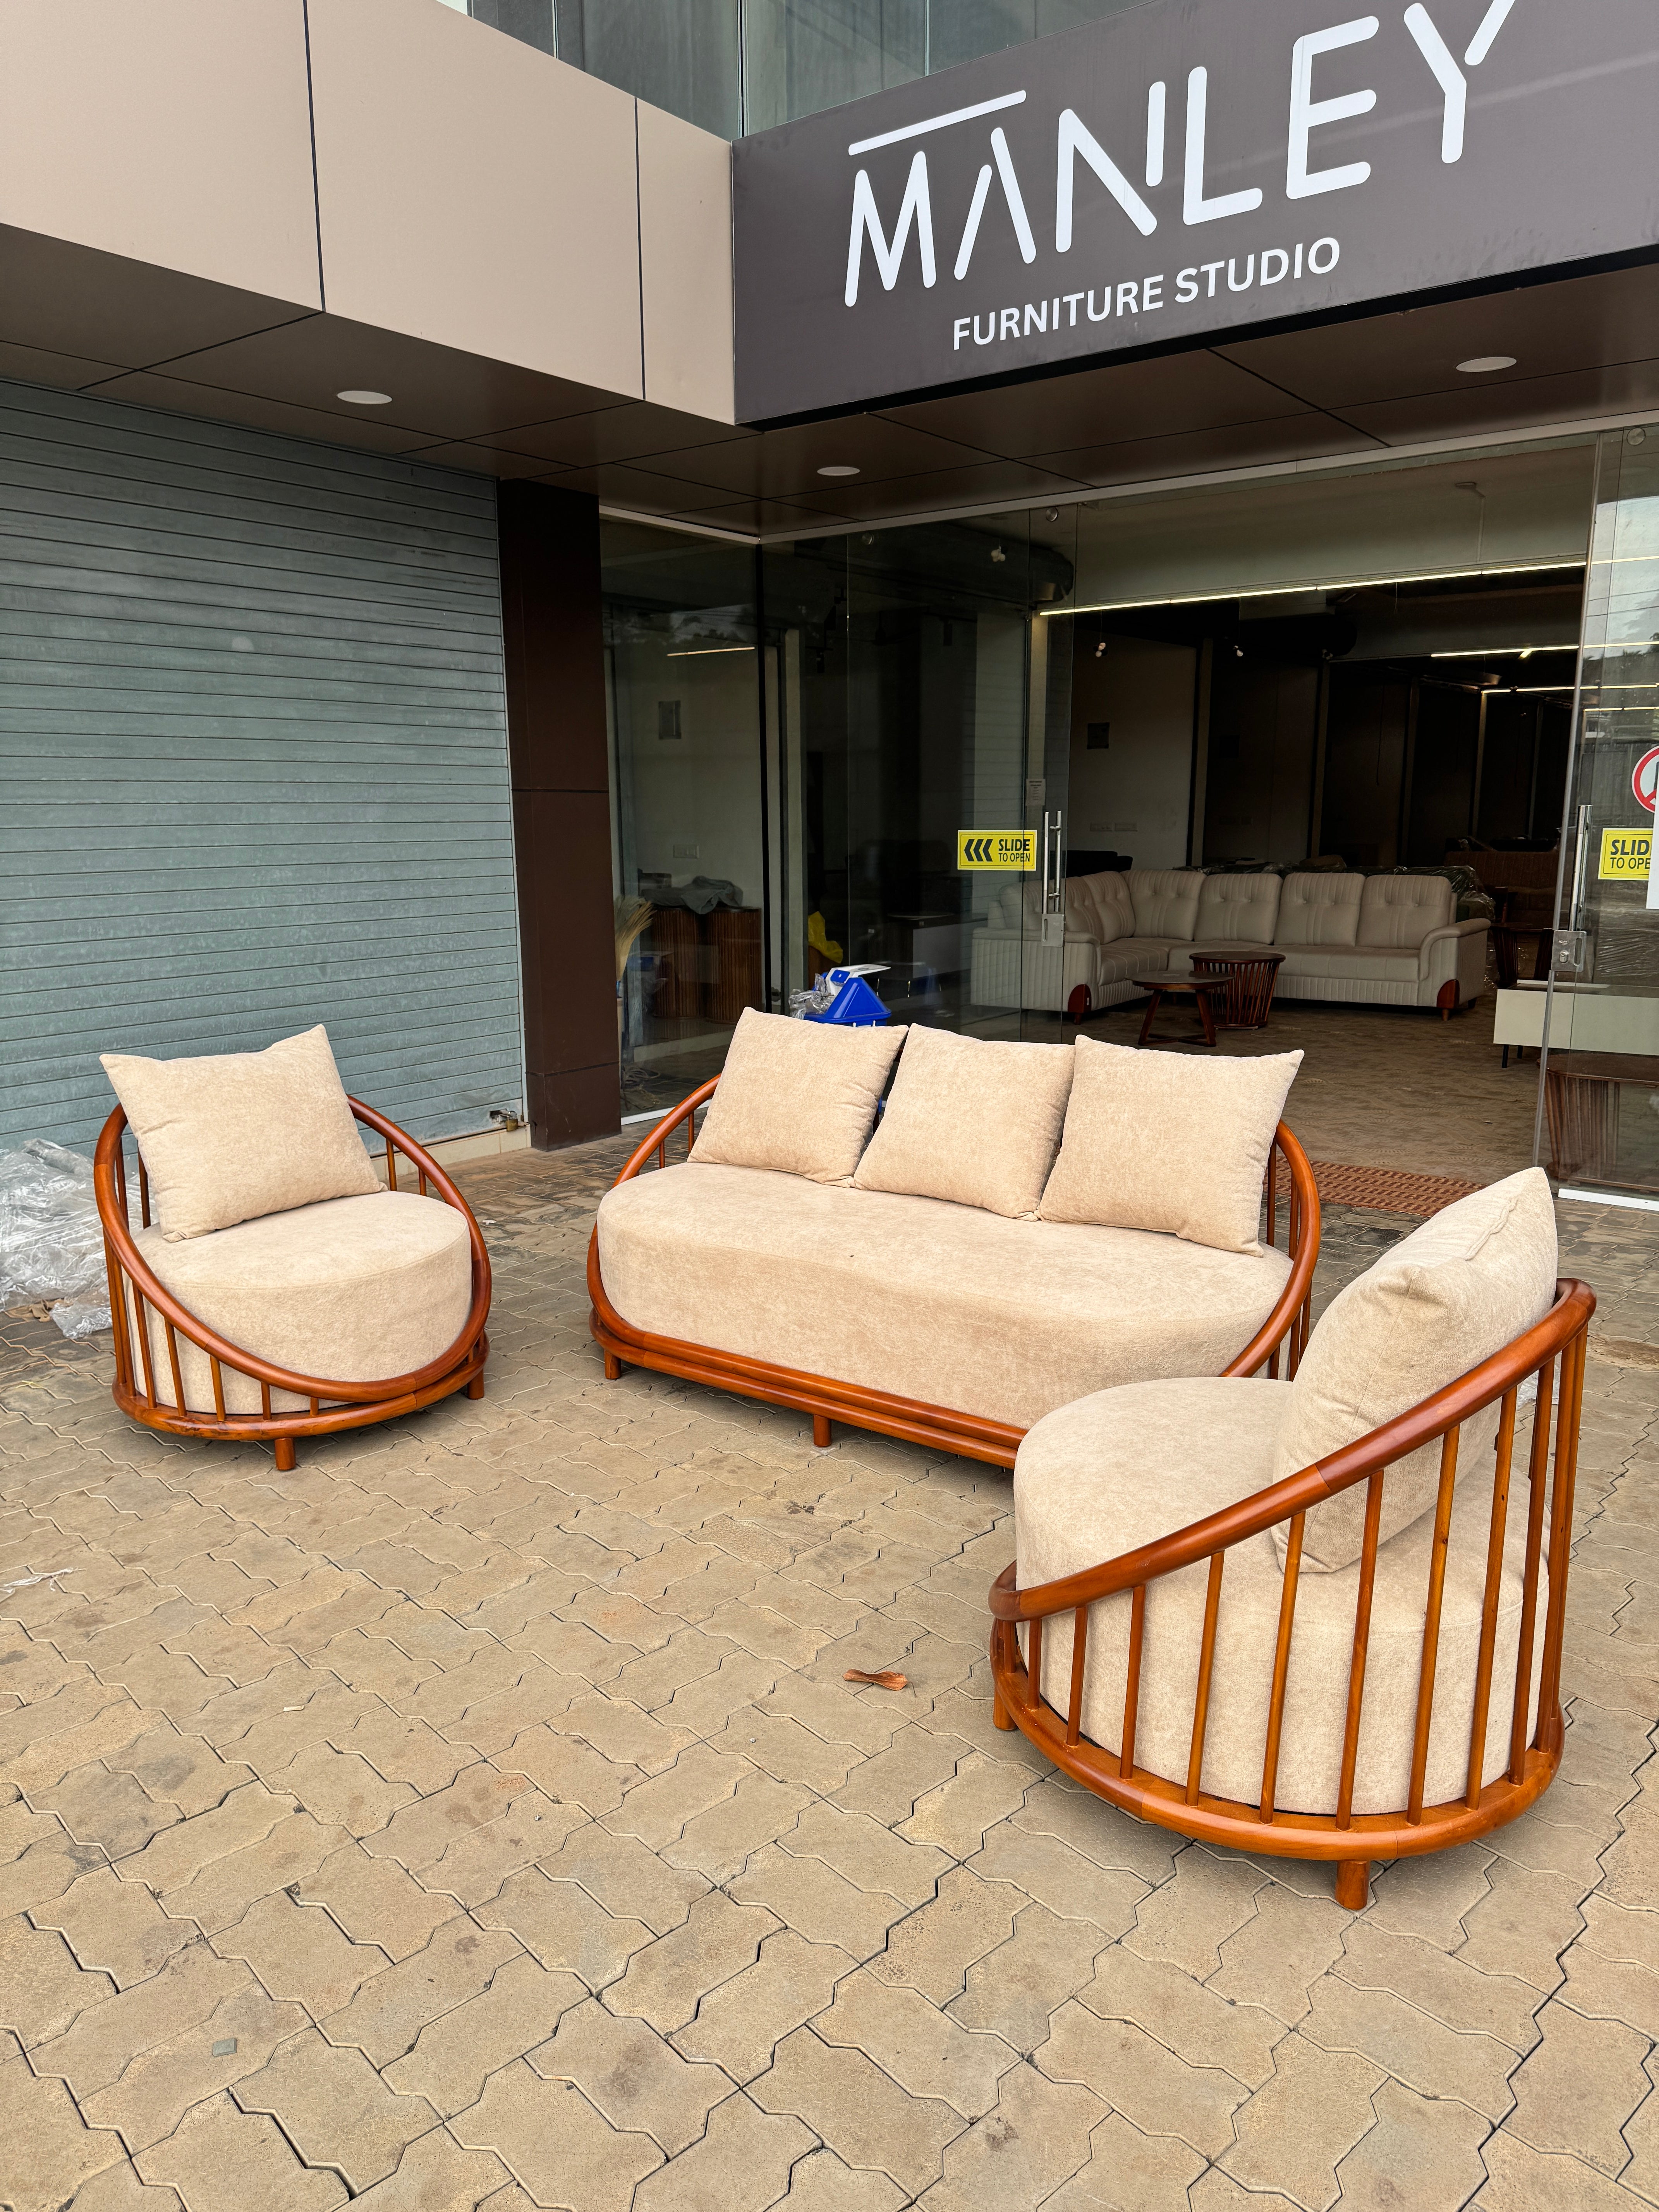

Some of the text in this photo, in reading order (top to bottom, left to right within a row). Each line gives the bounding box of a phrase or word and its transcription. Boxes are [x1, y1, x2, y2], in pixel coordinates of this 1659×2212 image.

[845, 0, 1515, 307] MANLEY
[953, 237, 1340, 350] FURNITURE STUDIO
[999, 839, 1030, 852] SLIDE
[1610, 839, 1650, 855] SLID
[999, 853, 1030, 862] TO OPEN
[1610, 857, 1651, 869] TO OPE
